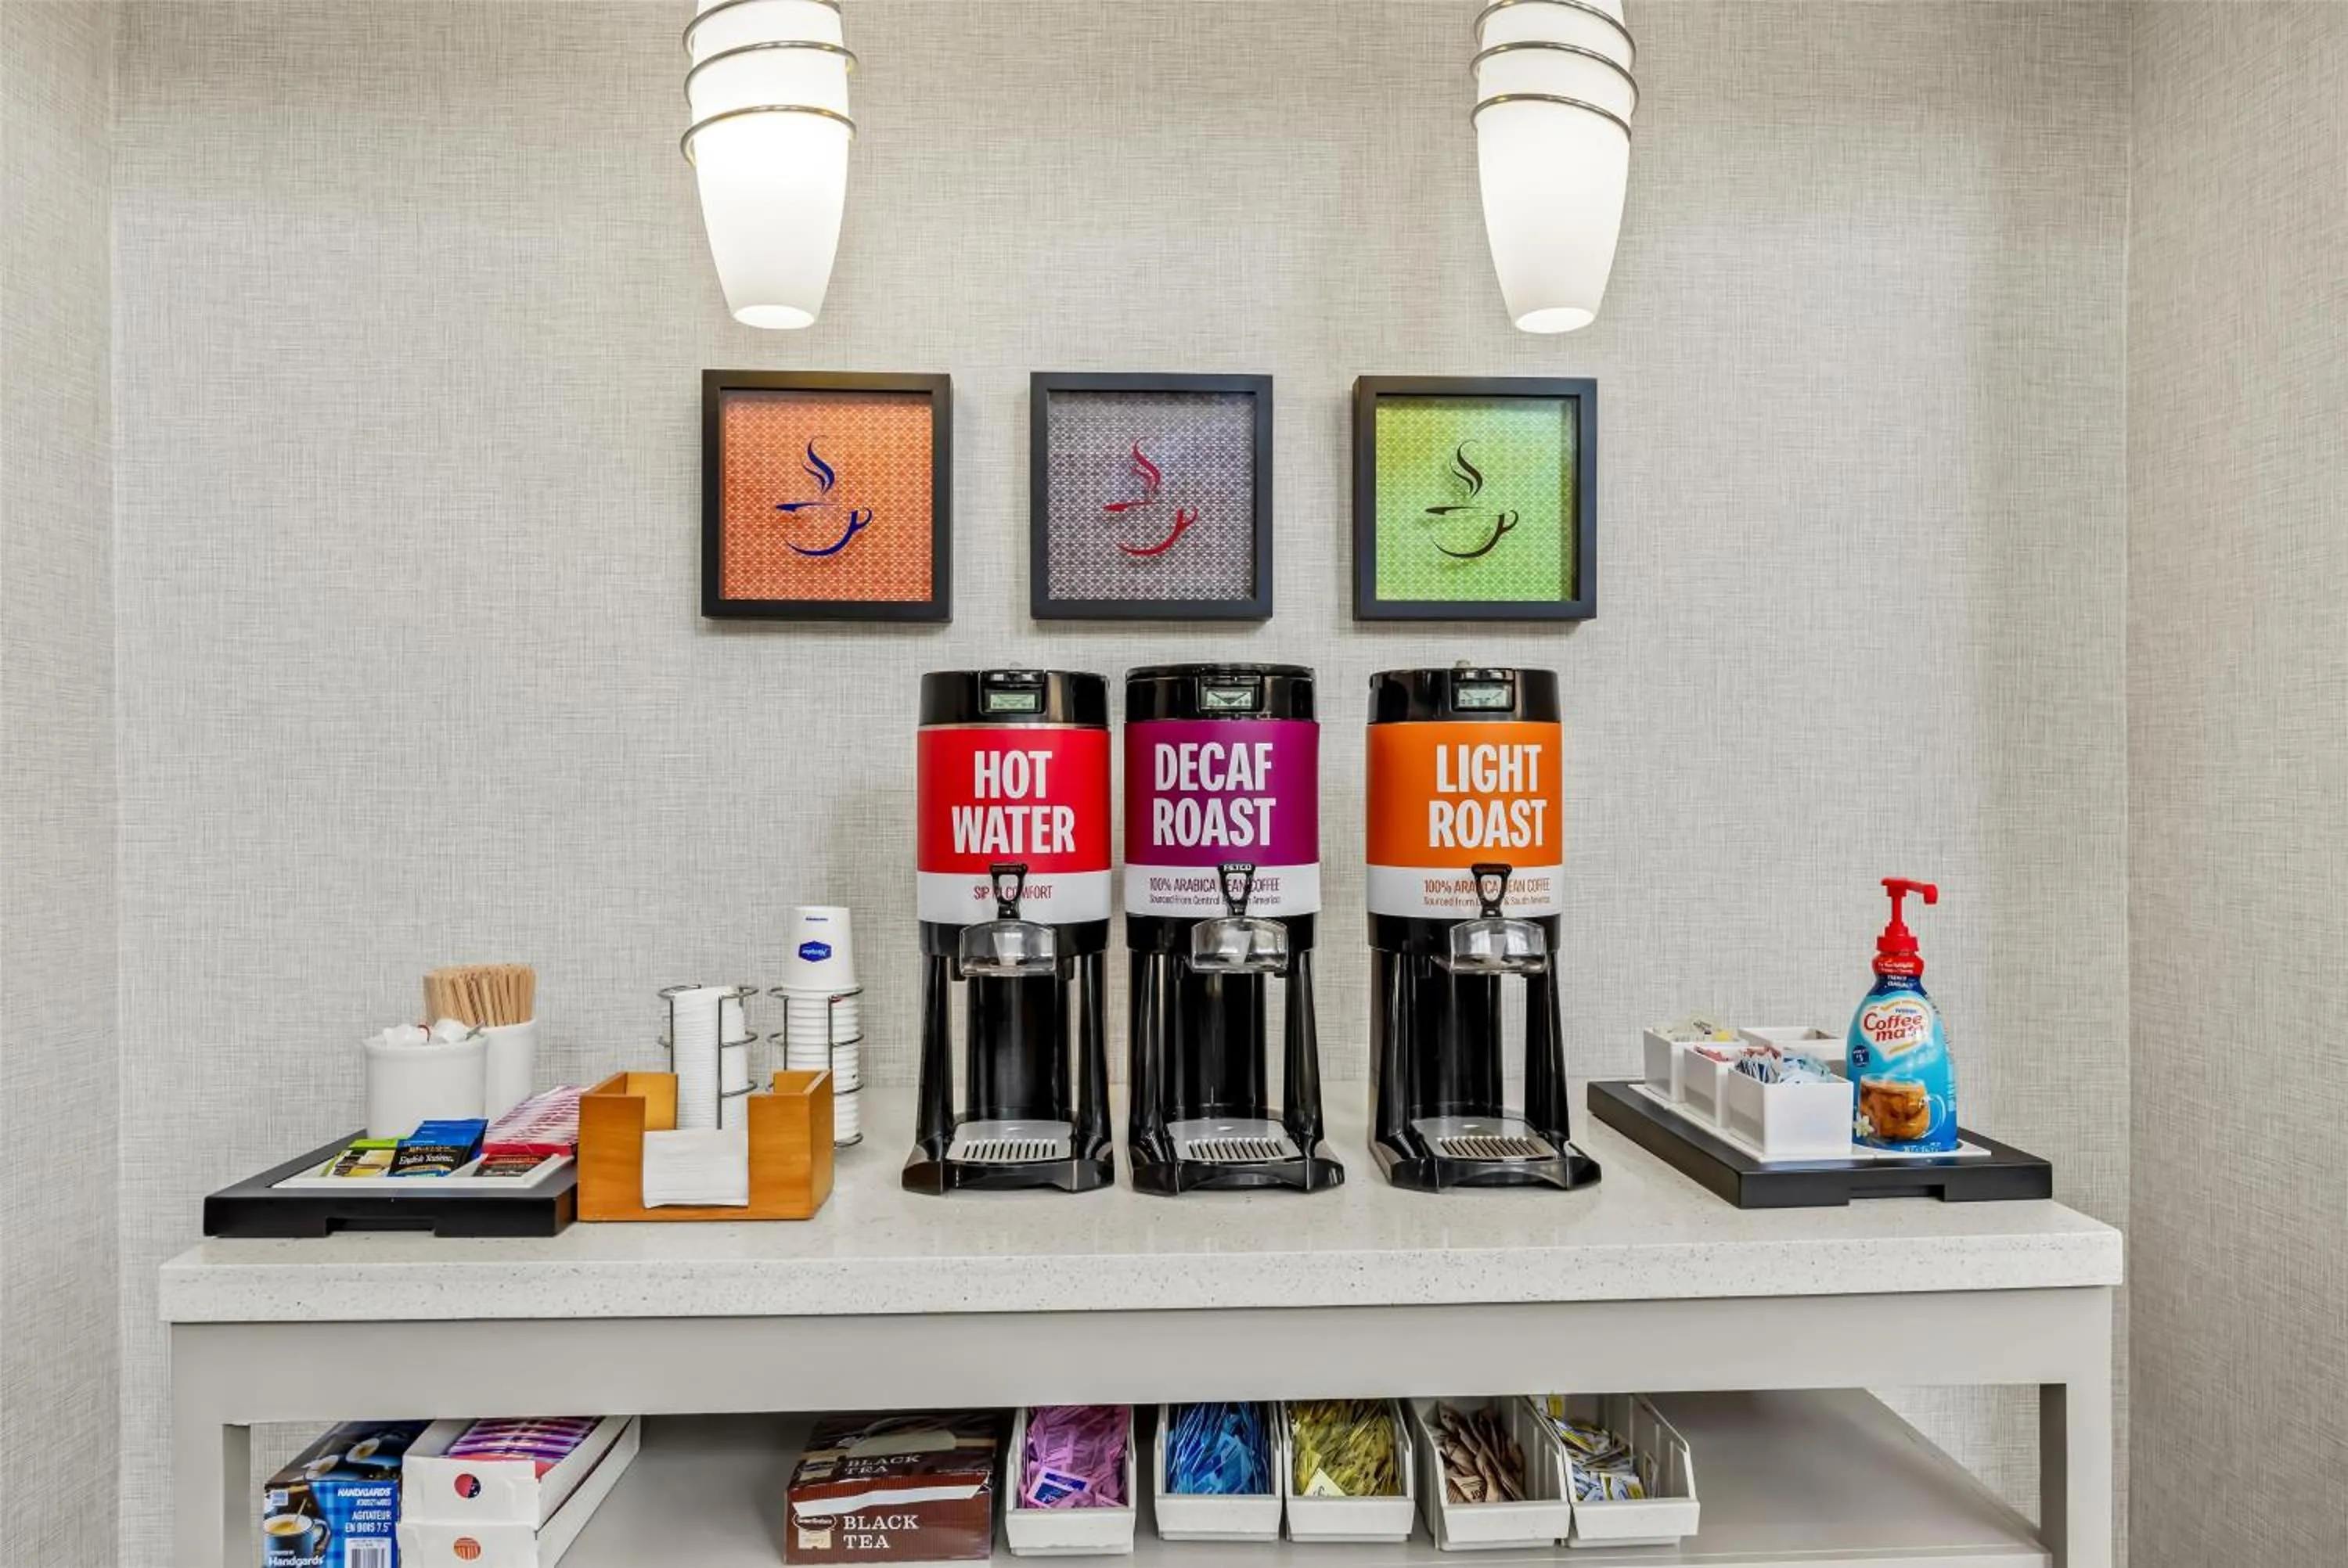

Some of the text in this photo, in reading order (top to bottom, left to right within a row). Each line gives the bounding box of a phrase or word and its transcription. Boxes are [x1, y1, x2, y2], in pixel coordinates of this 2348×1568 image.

[974, 750, 1052, 799] HOT
[1154, 743, 1273, 791] DECAF
[1435, 744, 1542, 793] LIGHT
[952, 805, 1076, 854] WATER
[1153, 797, 1277, 847] ROAST
[1429, 799, 1547, 848] ROAST
[974, 885, 990, 900] SIP
[1173, 878, 1216, 893] ARABICA
[1424, 879, 1452, 893] 100%
[1504, 878, 1525, 894] EAN
[1864, 1012, 1923, 1031] Coffee
[847, 1455, 922, 1467] BLACK
[845, 1466, 888, 1476] TEA
[843, 1514, 920, 1530] BLACK
[843, 1534, 890, 1548] TEA
